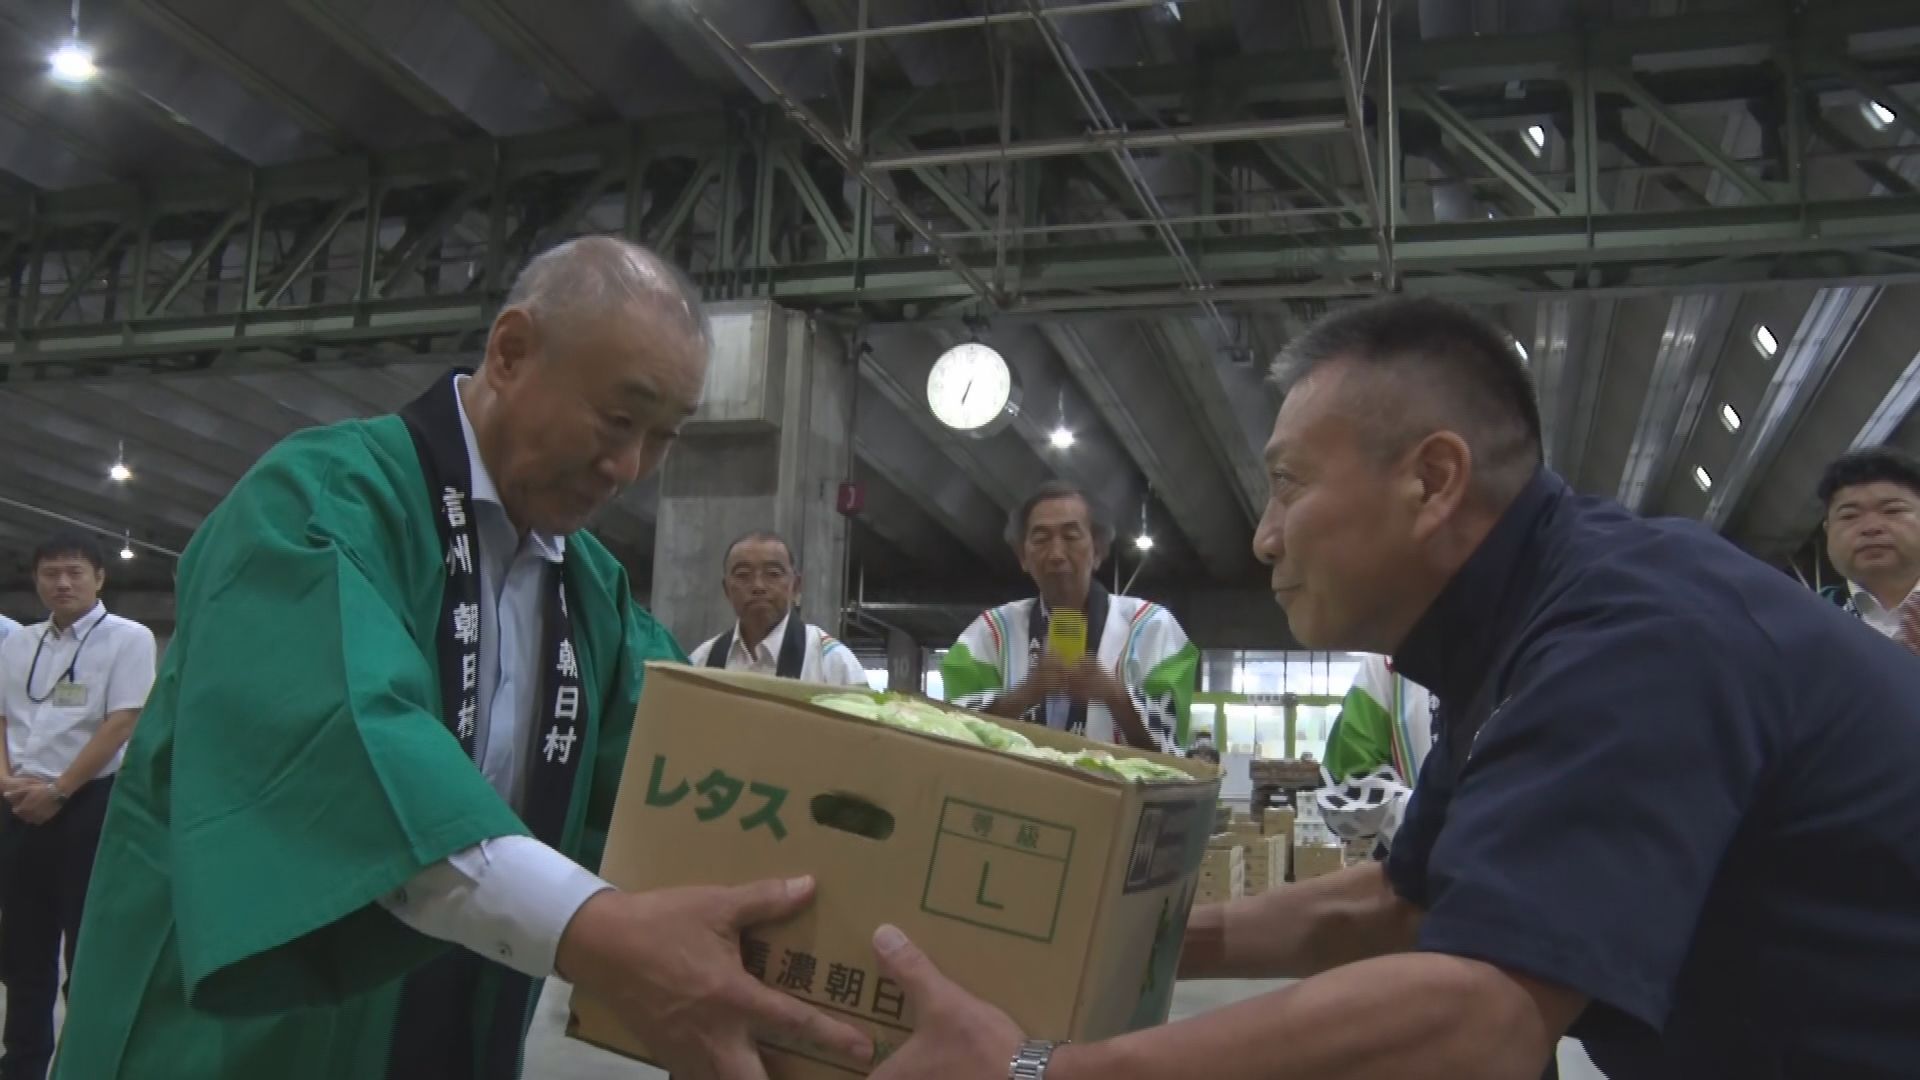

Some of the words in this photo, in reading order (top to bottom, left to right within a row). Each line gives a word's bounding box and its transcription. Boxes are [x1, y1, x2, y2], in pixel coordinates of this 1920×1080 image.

[543, 637, 579, 764] 朝日村
[645, 754, 789, 842] レタス
[976, 861, 1004, 910] L
